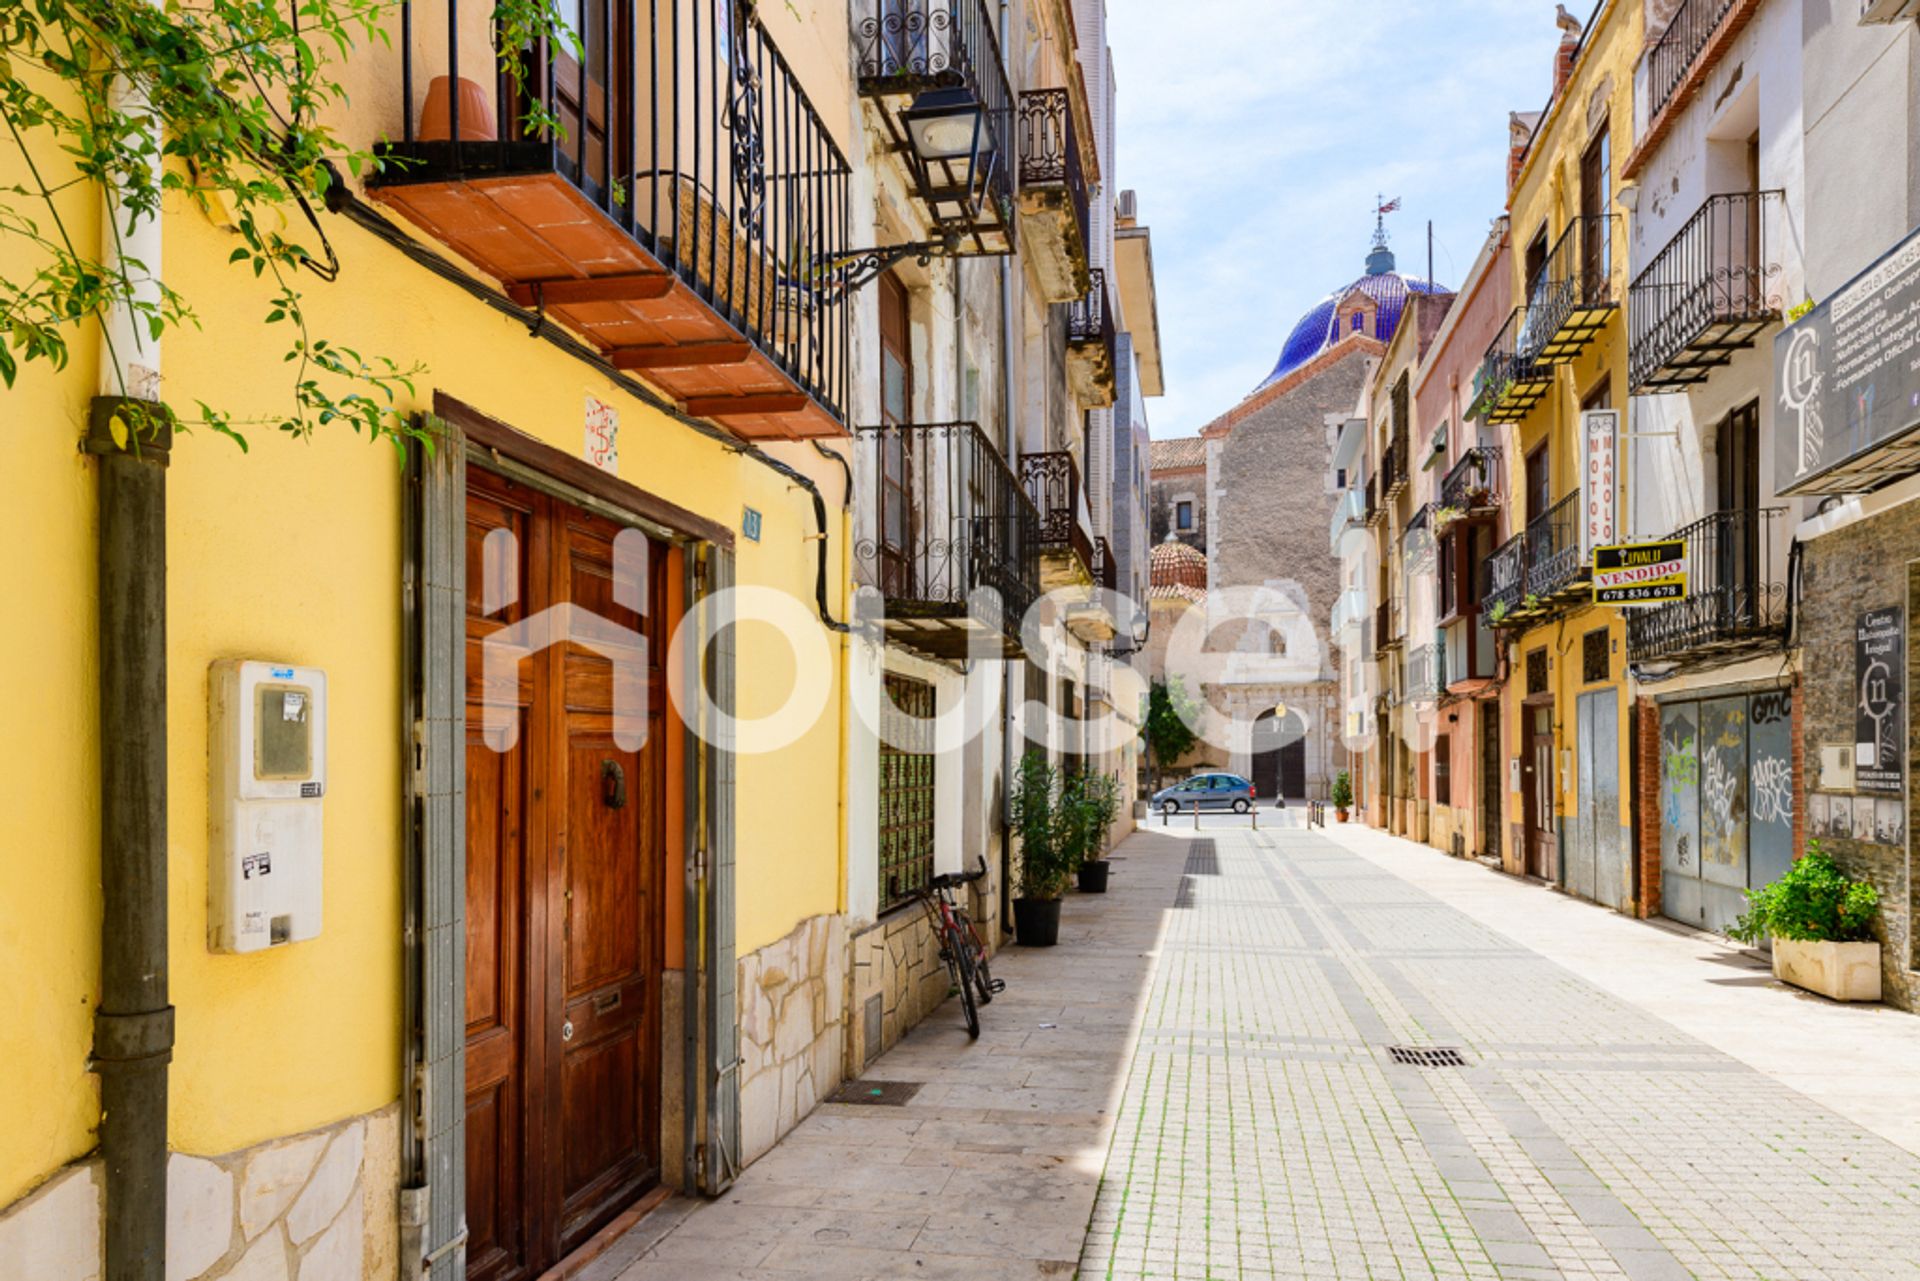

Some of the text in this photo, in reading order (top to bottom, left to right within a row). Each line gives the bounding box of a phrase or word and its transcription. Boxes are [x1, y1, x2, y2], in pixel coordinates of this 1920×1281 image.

[1875, 308, 1907, 337] Celular
[1881, 316, 1917, 349] Integral
[1884, 334, 1914, 362] Oficial
[1590, 438, 1598, 537] MOTOS
[1603, 435, 1612, 539] MANOLO
[1600, 560, 1682, 587] VENDIDO
[1603, 586, 1676, 601] 678 836 678
